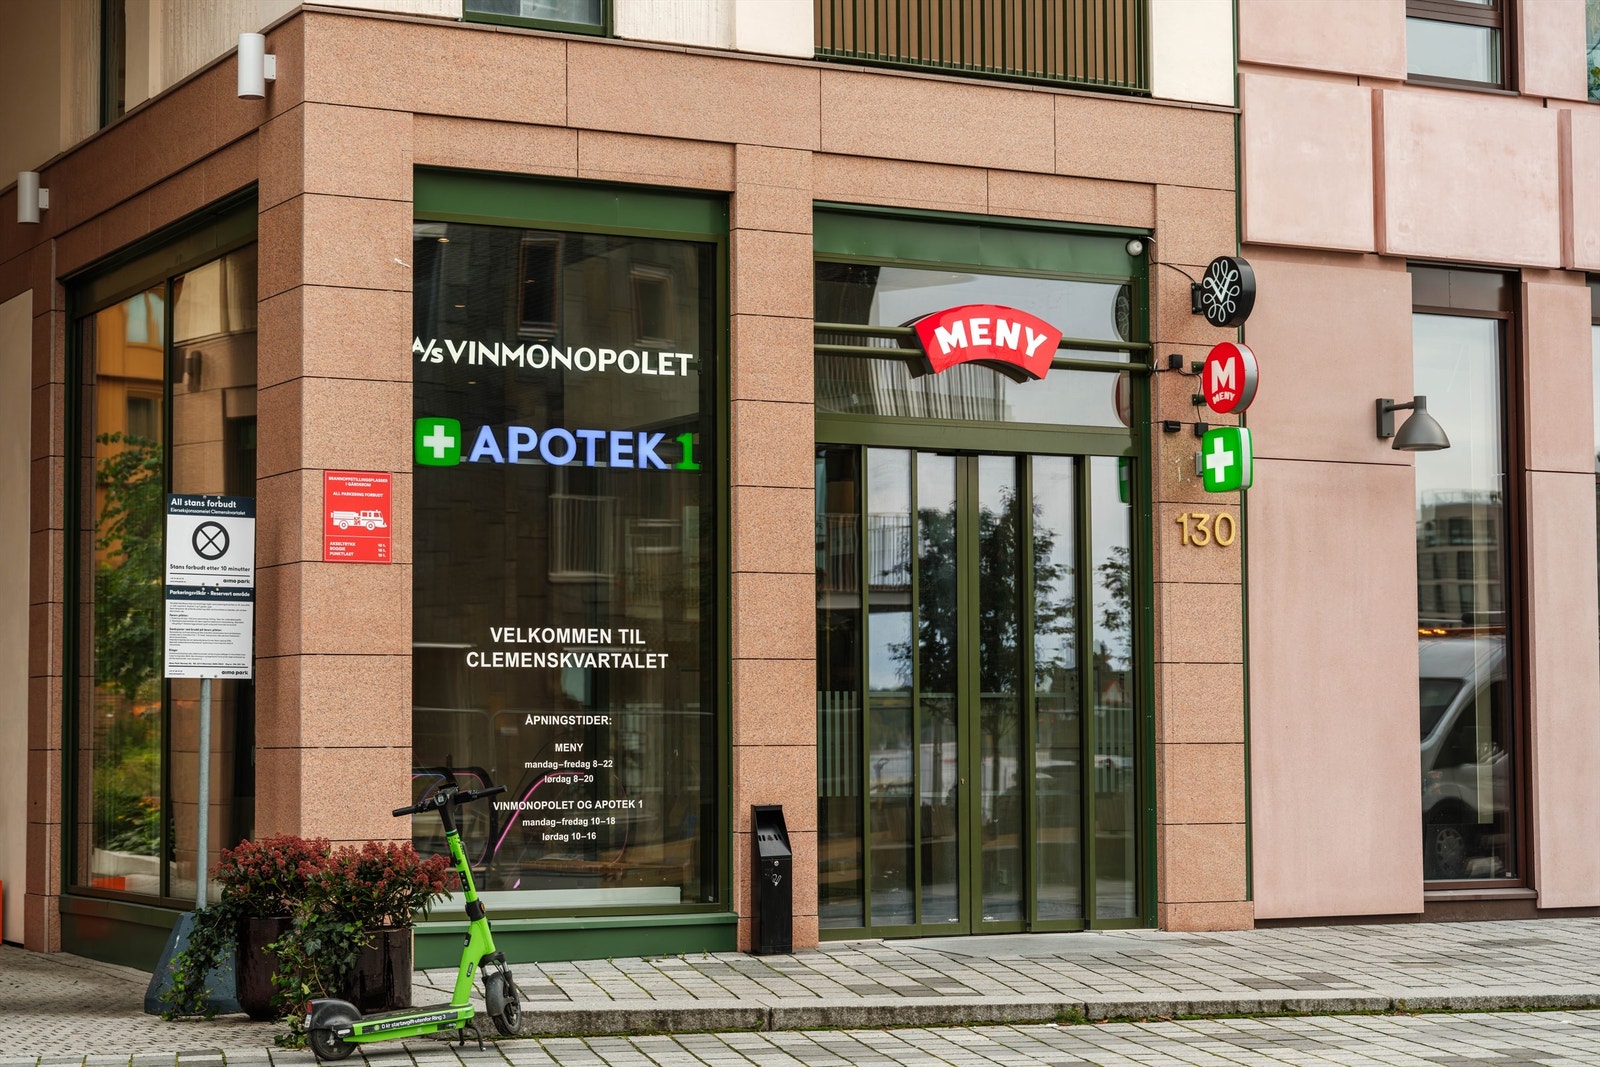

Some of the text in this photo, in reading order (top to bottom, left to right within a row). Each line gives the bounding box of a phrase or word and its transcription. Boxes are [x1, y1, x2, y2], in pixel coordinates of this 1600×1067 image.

[934, 317, 1048, 358] MENY
[444, 339, 693, 377] VINMONOPOLET
[1211, 356, 1236, 394] M
[1212, 391, 1236, 404] MENY
[468, 424, 700, 471] APOTEK 1
[171, 498, 182, 506] All
[206, 500, 236, 508] forbudt
[1176, 513, 1236, 546] 130
[490, 627, 646, 644] VELKOMMEN TIL
[466, 652, 668, 669] CLEMENSKVARTALET
[524, 714, 612, 726] ÅPNINGSTIDER:
[554, 743, 584, 752] MENY
[544, 775, 571, 784] lørdag
[493, 800, 644, 810] VINMONOPOLET OG APOTEK 1
[542, 832, 569, 841] lørdag
